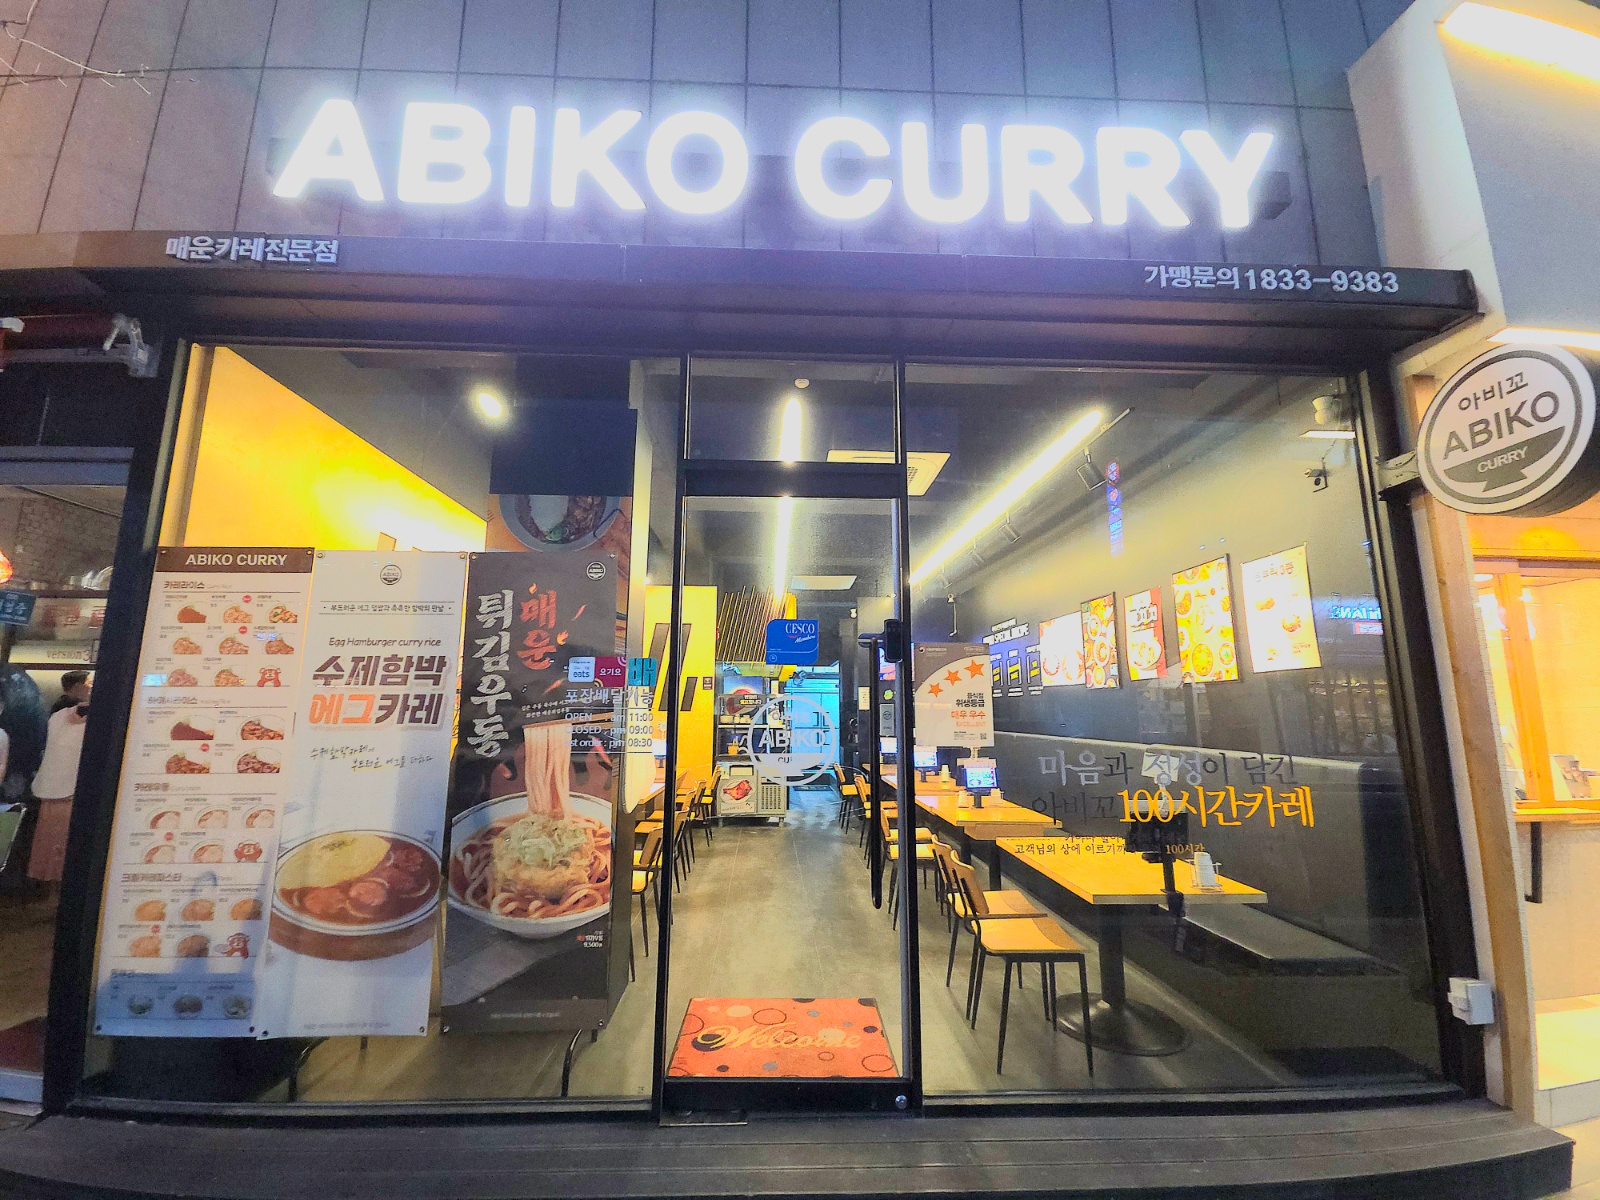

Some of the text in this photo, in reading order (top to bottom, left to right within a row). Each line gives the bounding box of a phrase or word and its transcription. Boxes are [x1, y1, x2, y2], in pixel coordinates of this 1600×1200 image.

[272, 98, 1274, 227] ABIKO CURRY
[165, 236, 338, 262] 매운카레전문점
[1144, 265, 1399, 293] 가맹문의 1833-9383
[1458, 372, 1528, 411] 아비꼬
[1443, 391, 1559, 460] ABIKO
[1477, 446, 1528, 473] CURRY
[185, 554, 287, 566] ABIKO CURRY
[328, 637, 441, 647] Egg Hamburger curry rice
[517, 590, 557, 670] 매운
[785, 623, 815, 634] CESCO
[312, 654, 447, 686] 수제함박
[467, 589, 514, 758] 튀김우동
[599, 668, 622, 676] 요기요
[308, 693, 444, 725] 에그카레
[565, 688, 654, 706] 포장배달가능
[565, 713, 592, 721] OPEN
[629, 713, 654, 721] 11:00
[629, 726, 654, 734] 09:00
[628, 739, 652, 747] 08:30
[758, 729, 827, 747] ABIKO
[1038, 749, 1298, 787] 마음과 정성이 담긴
[1117, 785, 1315, 828] 100시간카레
[1014, 843, 1056, 855] 고객님의
[1061, 843, 1081, 855] 상에
[696, 1021, 864, 1049] Welcome
